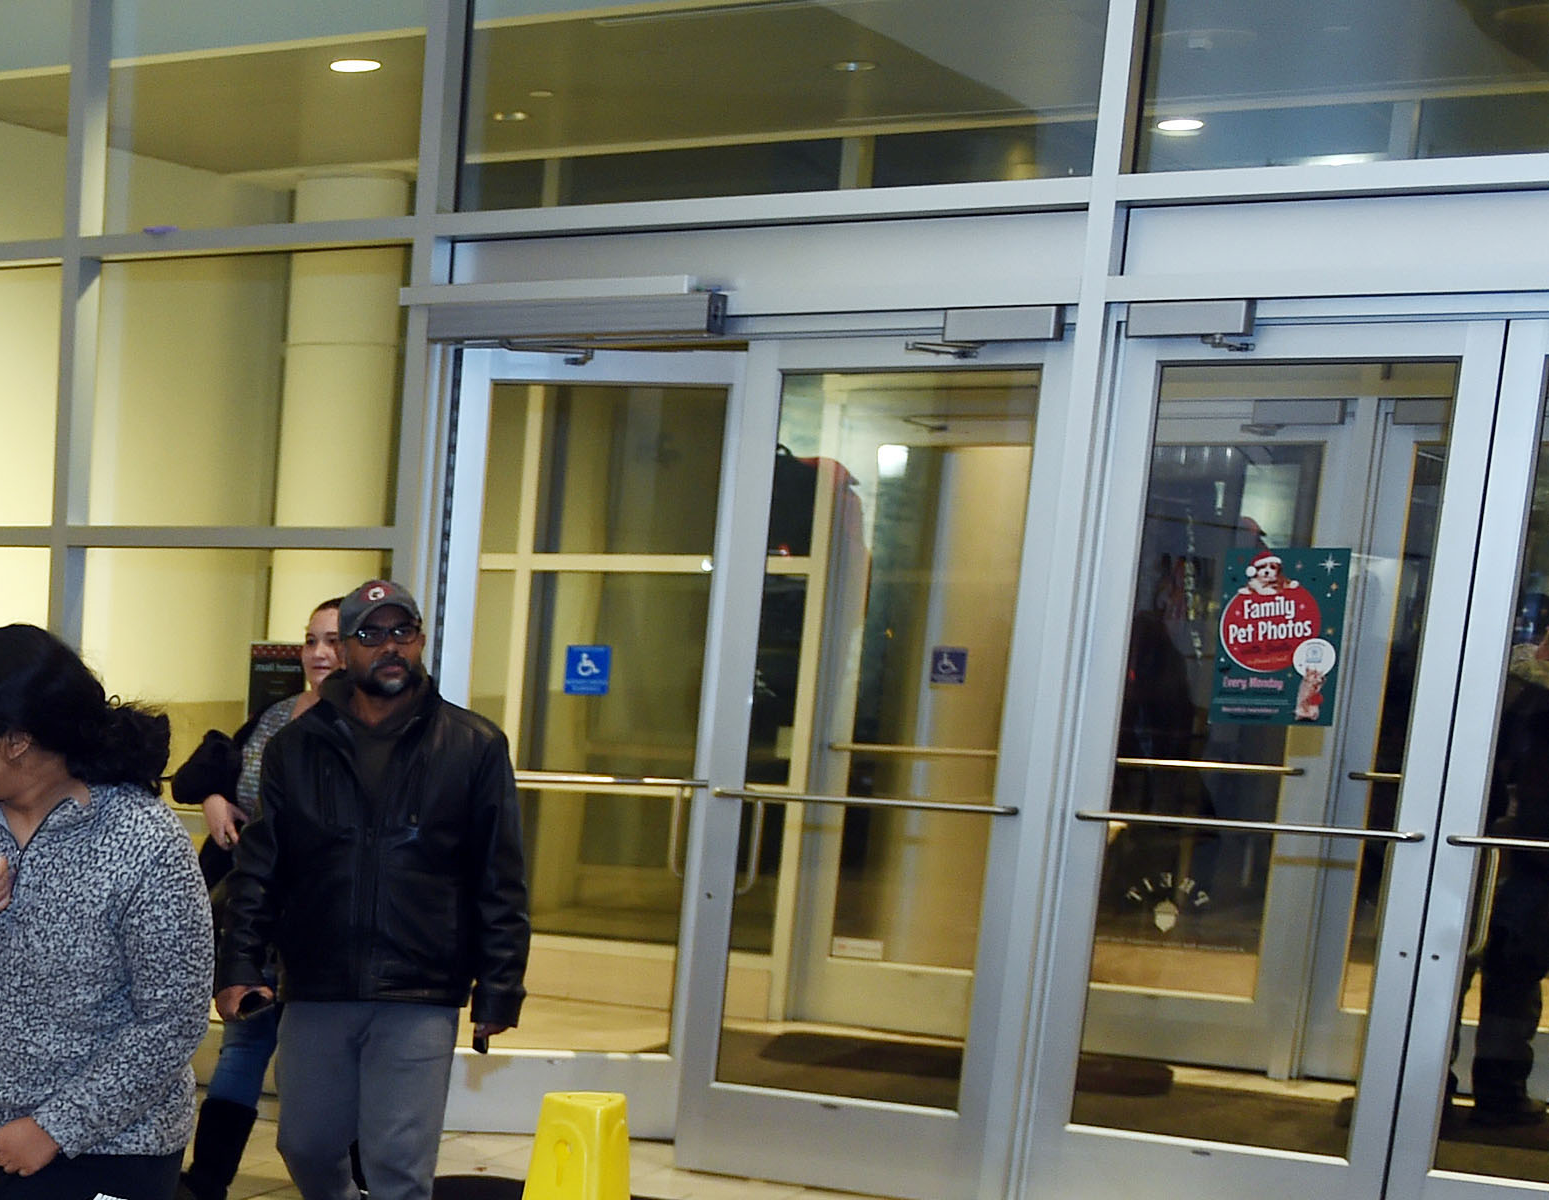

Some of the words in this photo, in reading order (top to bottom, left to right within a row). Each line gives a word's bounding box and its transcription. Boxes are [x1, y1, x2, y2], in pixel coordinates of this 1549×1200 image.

[1244, 595, 1295, 620] Family
[1229, 623, 1254, 645] Pet
[1258, 619, 1312, 642] Photos
